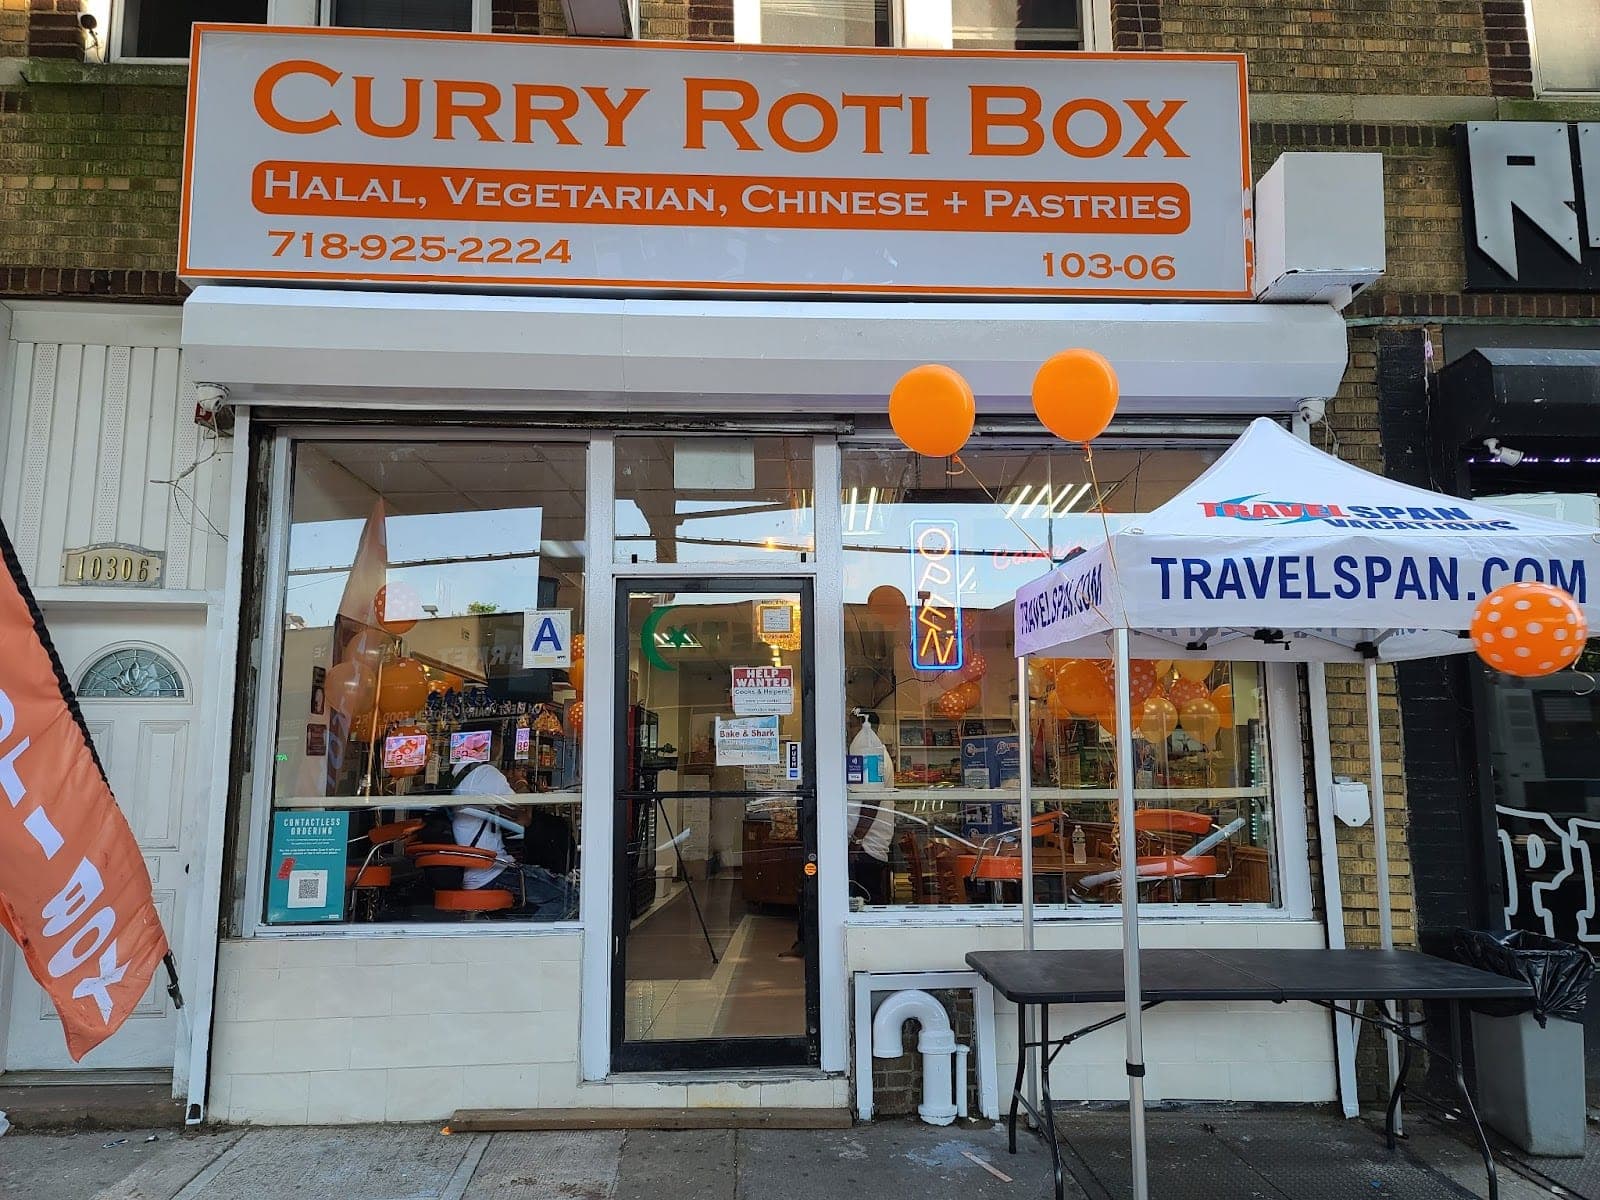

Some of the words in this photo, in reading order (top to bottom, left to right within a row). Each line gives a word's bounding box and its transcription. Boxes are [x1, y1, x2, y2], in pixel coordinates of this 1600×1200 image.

[253, 60, 650, 148] CURRY
[684, 77, 931, 154] ROTI
[968, 86, 1190, 159] BOX
[264, 169, 428, 209] HALAL,
[441, 176, 728, 217] VEGETARIAN,
[741, 185, 929, 216] CHINESE
[944, 193, 968, 213] +
[983, 189, 1182, 220] PASTRIES
[1466, 120, 1600, 282] R
[268, 230, 573, 264] 718-925-2224
[1043, 252, 1176, 281] 103-06
[77, 555, 149, 582] 10306
[1150, 555, 1587, 604] TRAVELSPAN.COM
[917, 528, 955, 664] OPEN
[531, 617, 563, 652] A
[735, 678, 790, 688] WANTED
[746, 668, 779, 678] HELP
[719, 730, 740, 738] Bake
[743, 729, 748, 737] &
[751, 728, 775, 737] Shark
[283, 817, 341, 827] CONTACTLESS
[290, 826, 333, 835] ORDERING
[41, 856, 132, 1026] BOX
